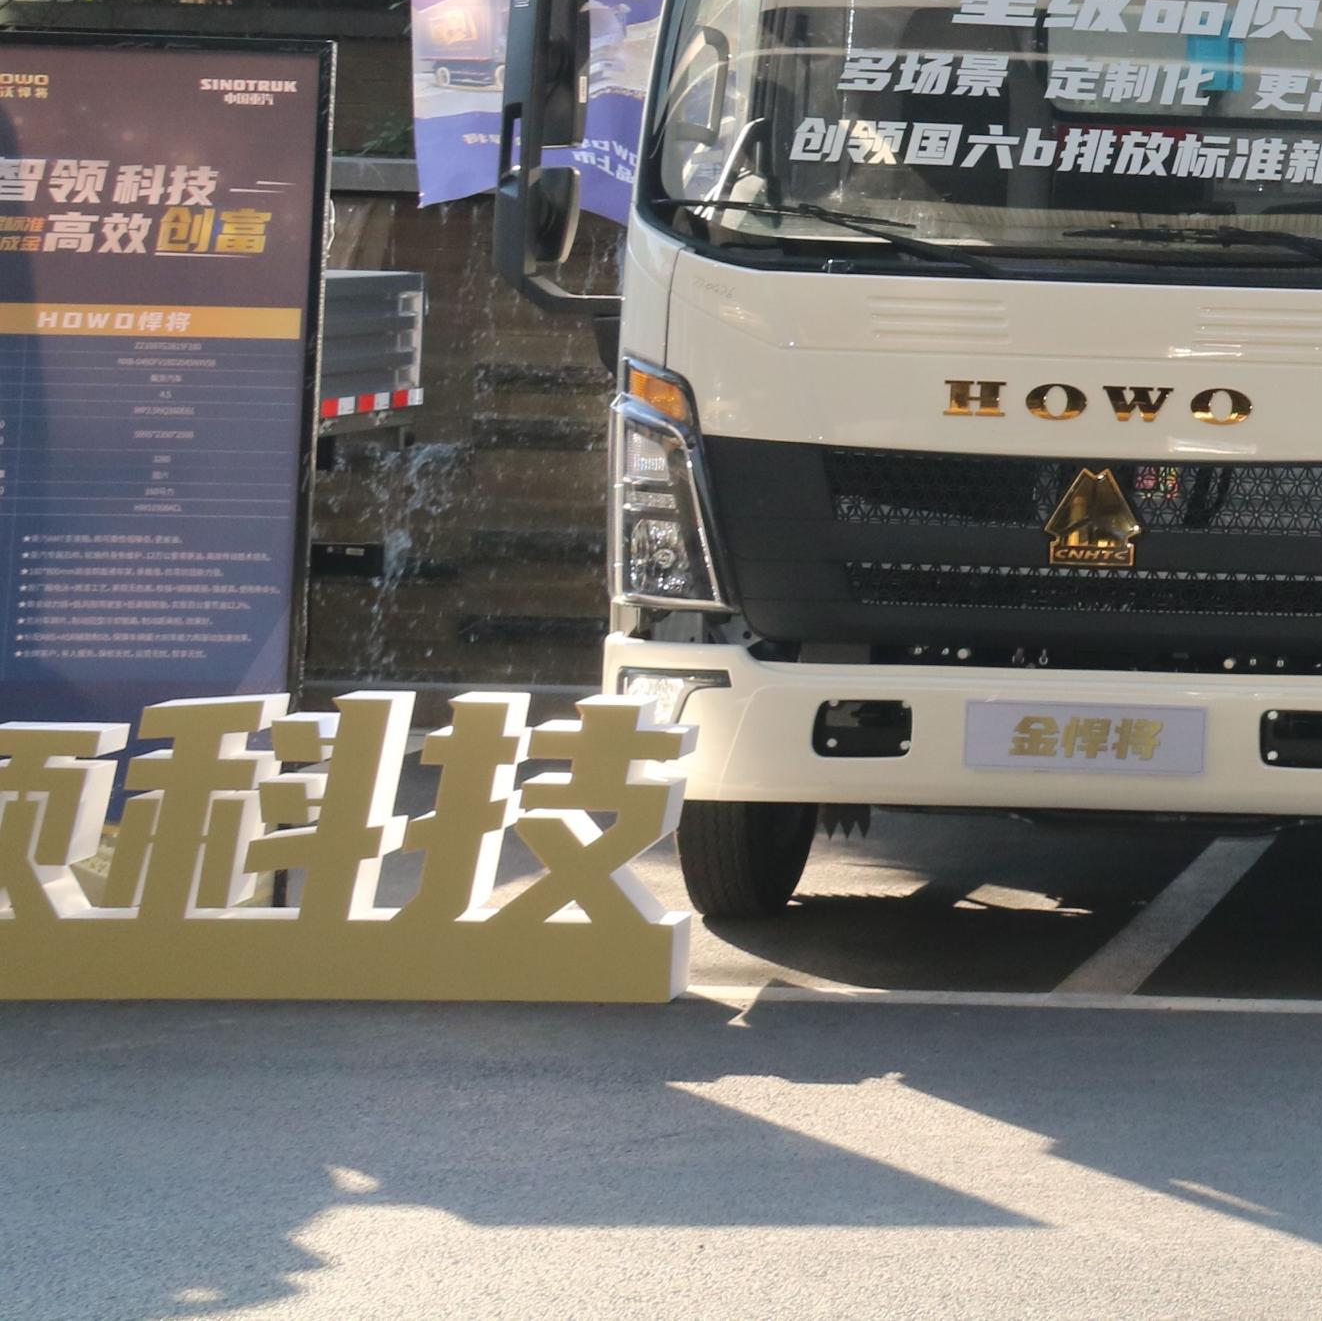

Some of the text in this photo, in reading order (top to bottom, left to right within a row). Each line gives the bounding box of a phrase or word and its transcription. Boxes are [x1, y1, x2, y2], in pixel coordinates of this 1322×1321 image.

[200, 78, 297, 93] SINOTRUK
[838, 47, 1010, 98] 多场景
[1044, 54, 1214, 109] 定制化
[0, 157, 219, 206] 智领科技
[0, 235, 42, 252] 成金
[43, 207, 272, 254] 高效创富
[37, 311, 192, 332] HOWO悍将
[943, 379, 1253, 426] HOWO
[1054, 547, 1129, 562] CNHTC
[1008, 713, 1163, 761] 金悍将
